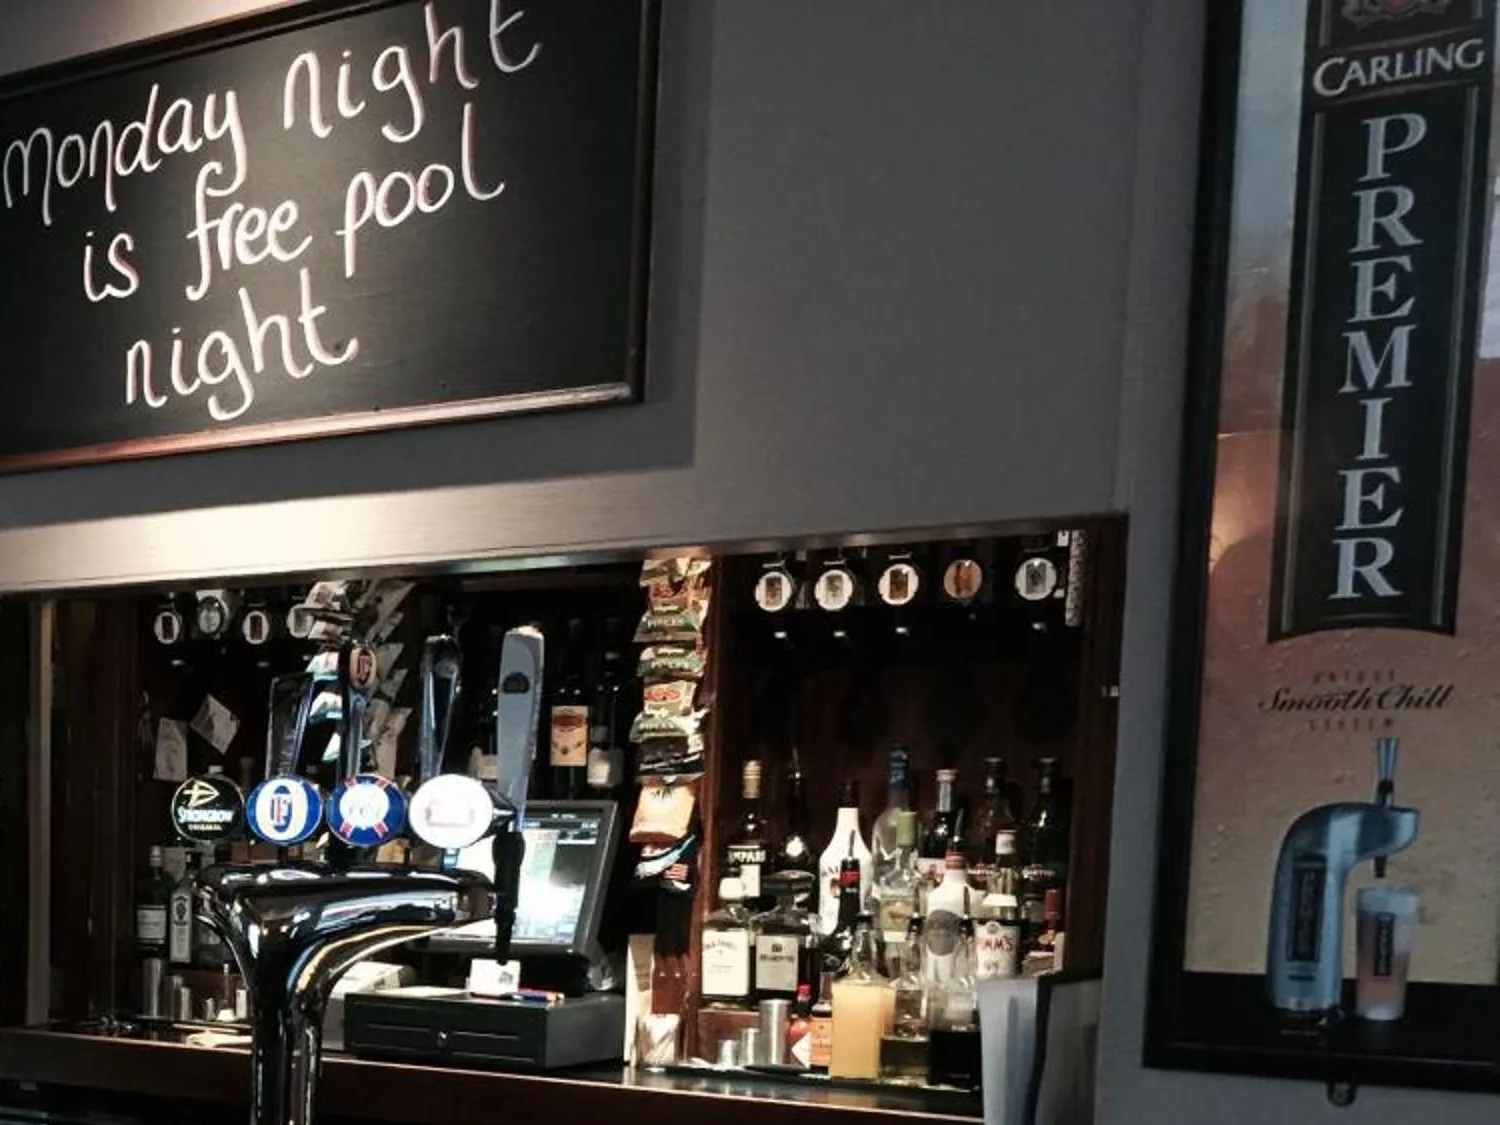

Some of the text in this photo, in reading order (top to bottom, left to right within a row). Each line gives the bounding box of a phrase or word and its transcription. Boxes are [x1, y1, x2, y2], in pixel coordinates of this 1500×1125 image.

[1313, 38, 1485, 97] CARLING
[83, 103, 505, 302] is free pool
[127, 268, 359, 420] night
[1328, 111, 1428, 600] PREMIER
